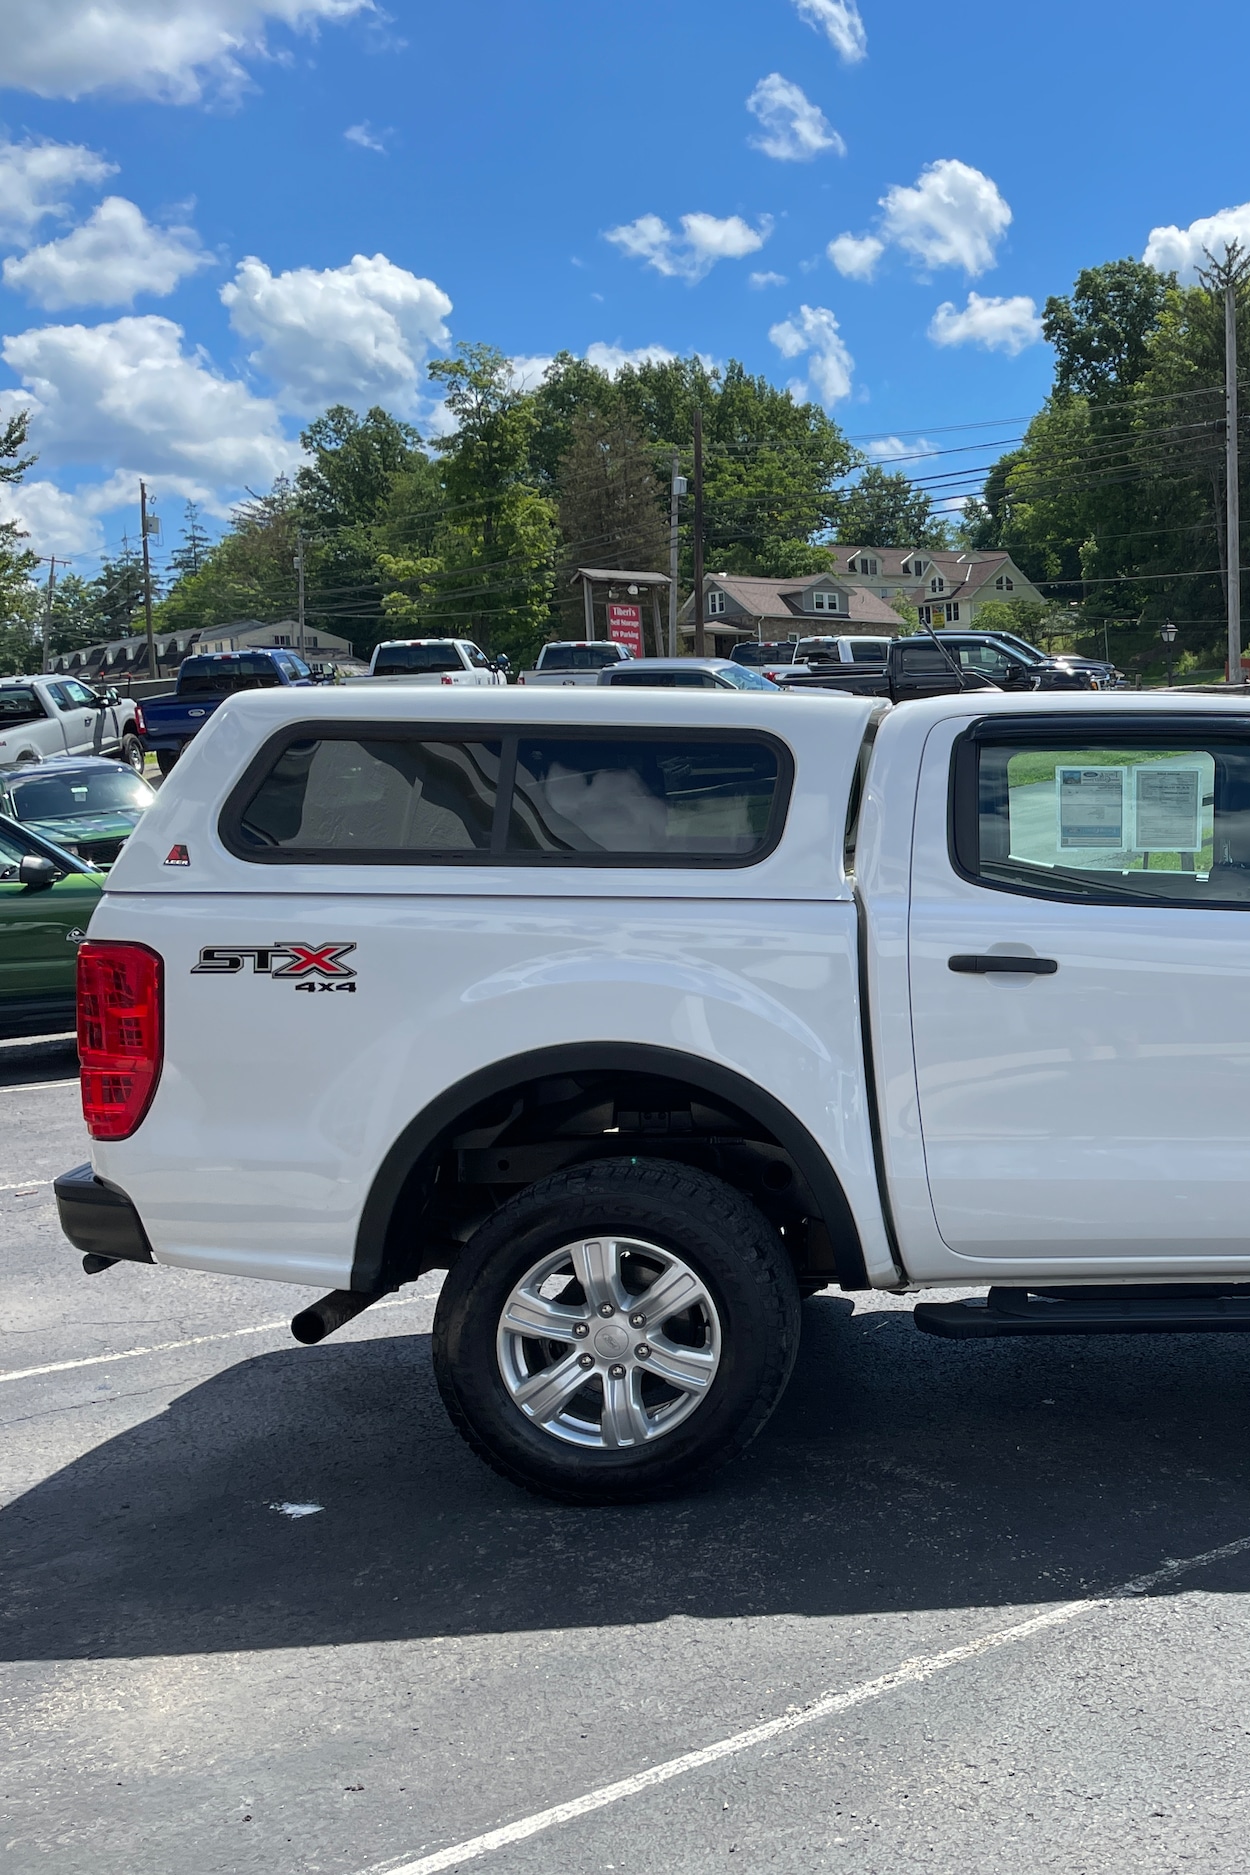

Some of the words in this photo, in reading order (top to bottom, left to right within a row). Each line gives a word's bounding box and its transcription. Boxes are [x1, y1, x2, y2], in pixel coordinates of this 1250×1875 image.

[620, 630, 639, 640] Parking
[164, 858, 189, 866] LEER
[190, 941, 358, 979] STX
[294, 981, 357, 993] 4x4
